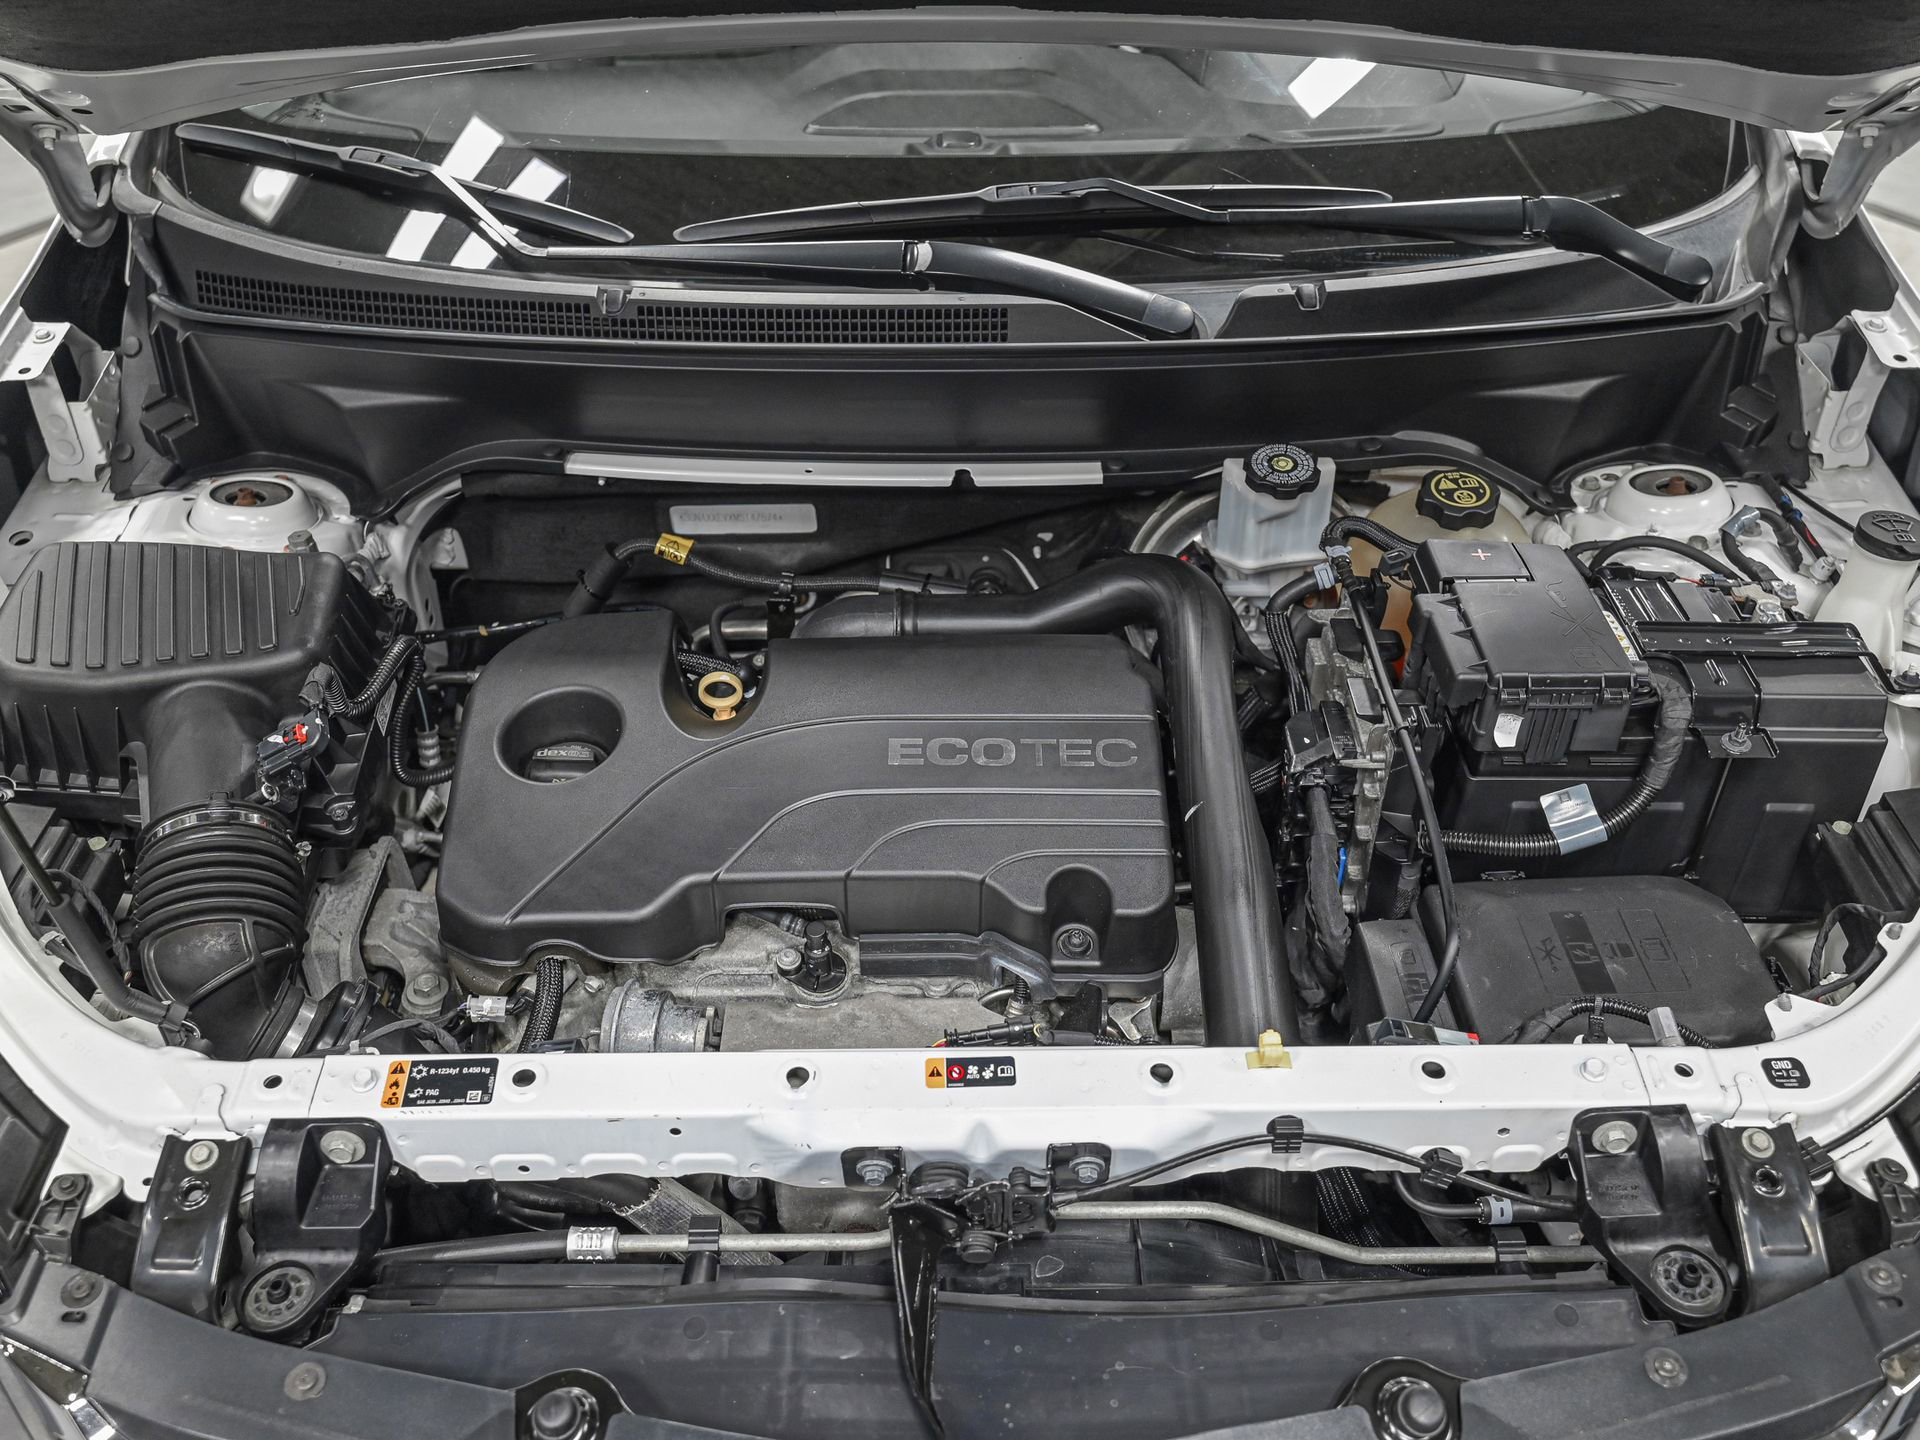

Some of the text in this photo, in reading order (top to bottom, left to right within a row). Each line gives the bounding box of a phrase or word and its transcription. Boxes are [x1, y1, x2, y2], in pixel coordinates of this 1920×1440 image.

[887, 737, 1138, 767] ECOTEC
[1771, 1060, 1792, 1070] GND
[429, 1066, 491, 1076] R-1234yf 0.450 kg
[425, 1088, 440, 1096] PAG
